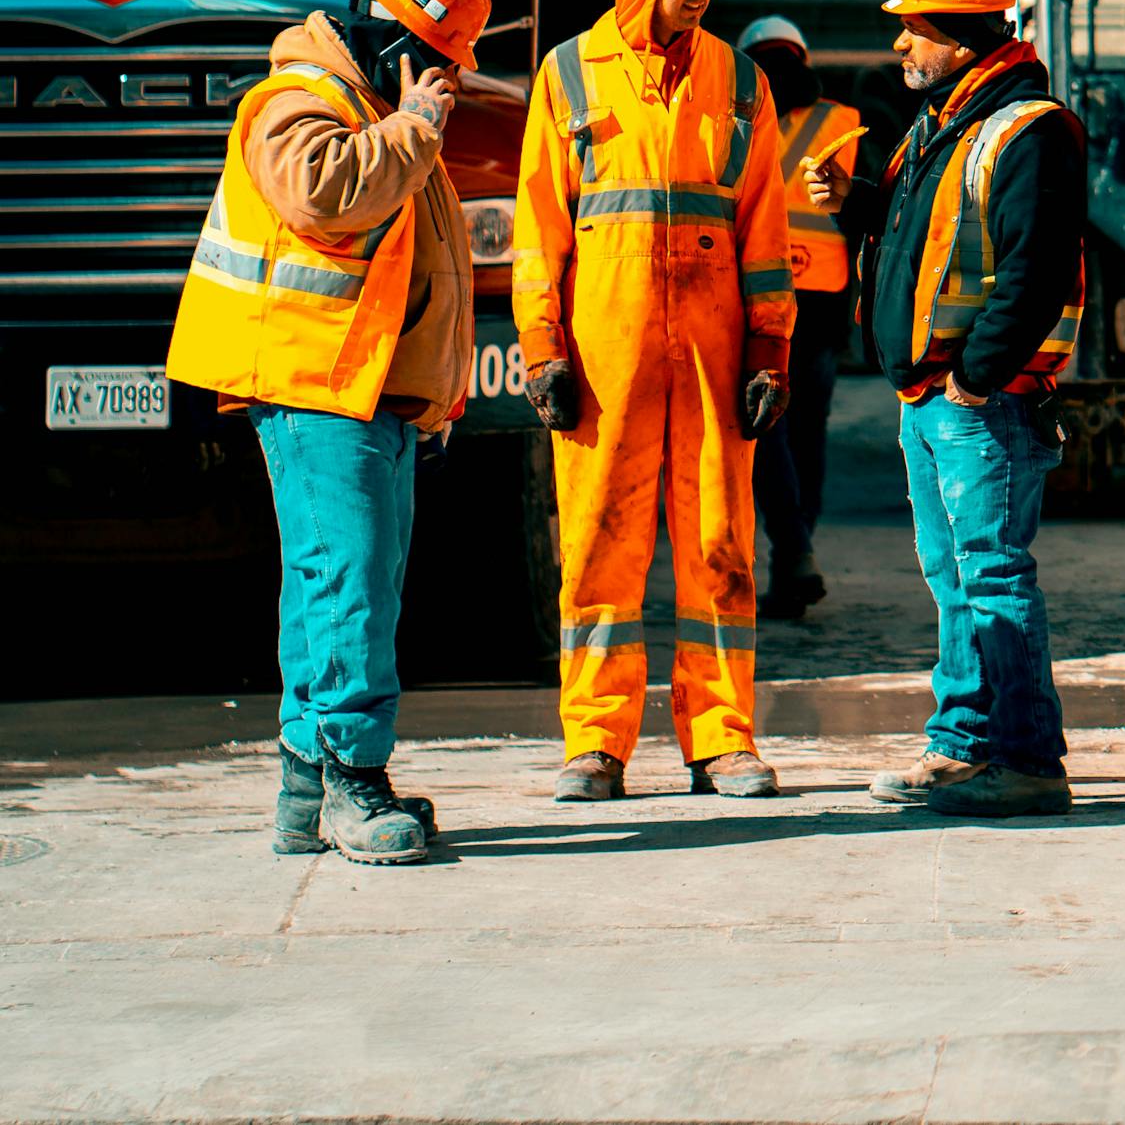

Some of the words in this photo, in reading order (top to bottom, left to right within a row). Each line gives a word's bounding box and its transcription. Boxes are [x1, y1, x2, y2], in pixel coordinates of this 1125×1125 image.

[0, 74, 270, 108] ACK
[53, 381, 80, 414] AX
[95, 381, 165, 414] 70989
